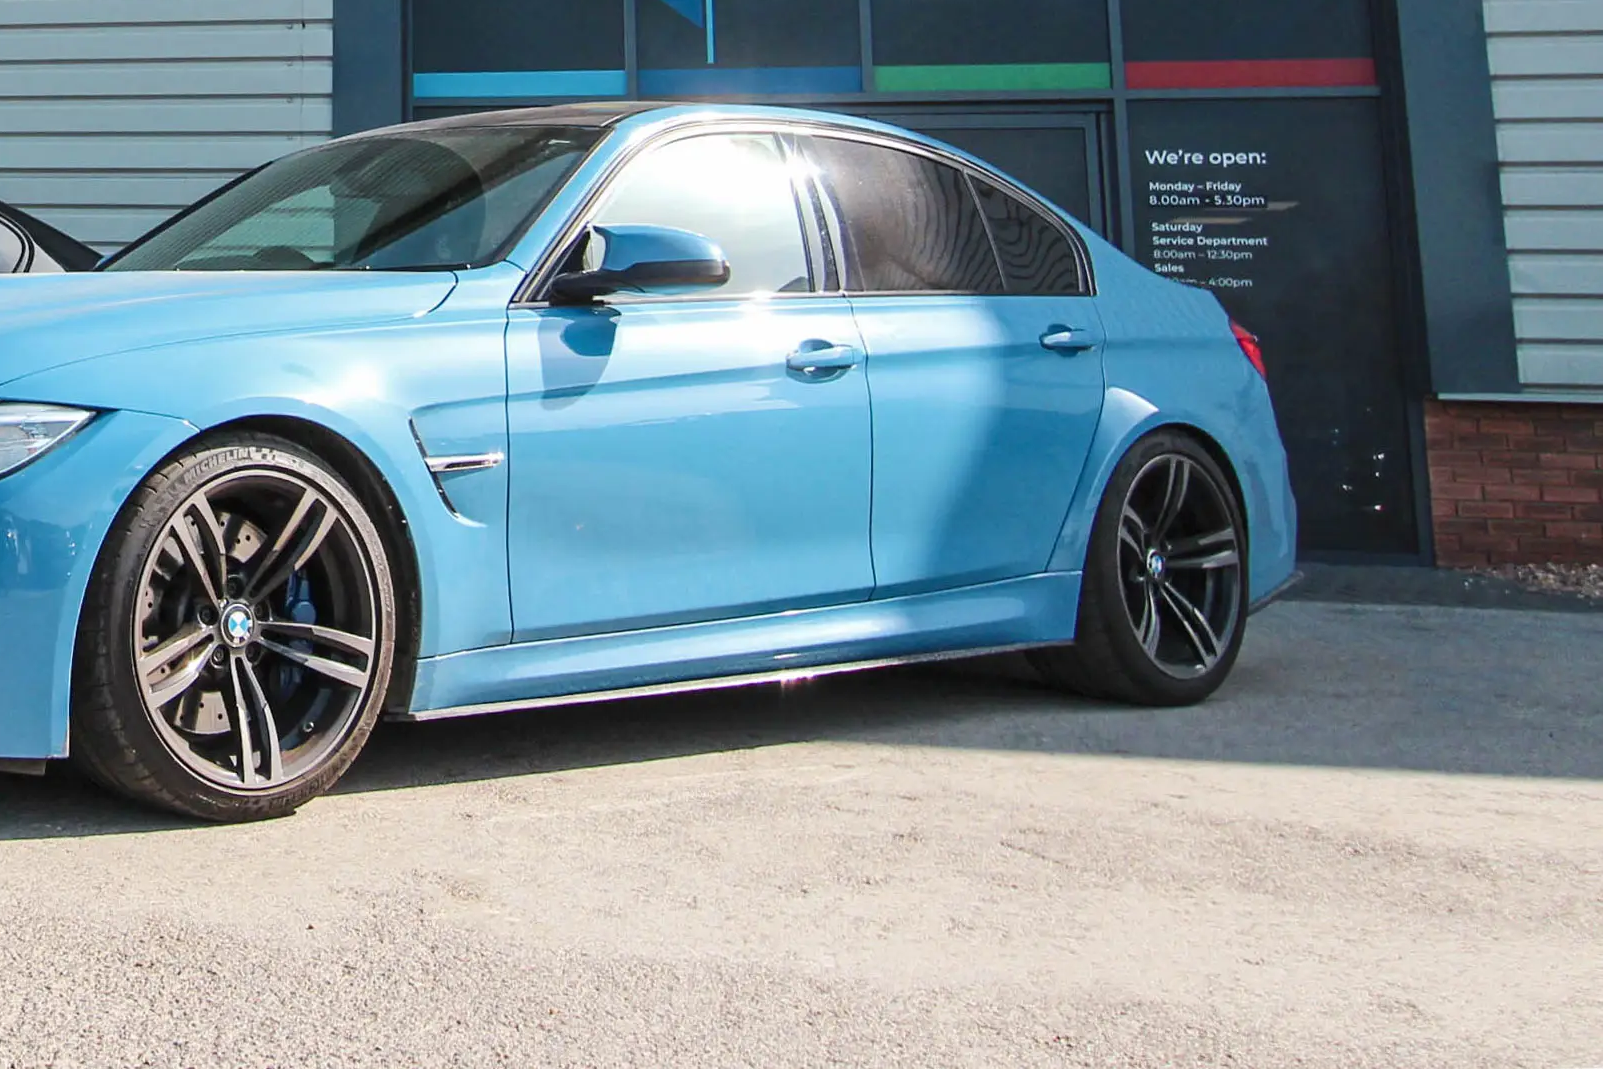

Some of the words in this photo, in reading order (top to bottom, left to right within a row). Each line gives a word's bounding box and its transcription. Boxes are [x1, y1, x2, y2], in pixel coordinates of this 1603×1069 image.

[1145, 149, 1203, 164] We're
[1209, 151, 1266, 168] open:
[1149, 181, 1194, 192] Monday
[1206, 181, 1241, 192] Friday
[1149, 195, 1200, 205] 8.00am
[1214, 195, 1265, 207] 5.30pm
[1151, 222, 1203, 233] Saturday
[1152, 236, 1194, 245] Service
[1197, 236, 1268, 246] Department
[1154, 263, 1184, 273] Sales
